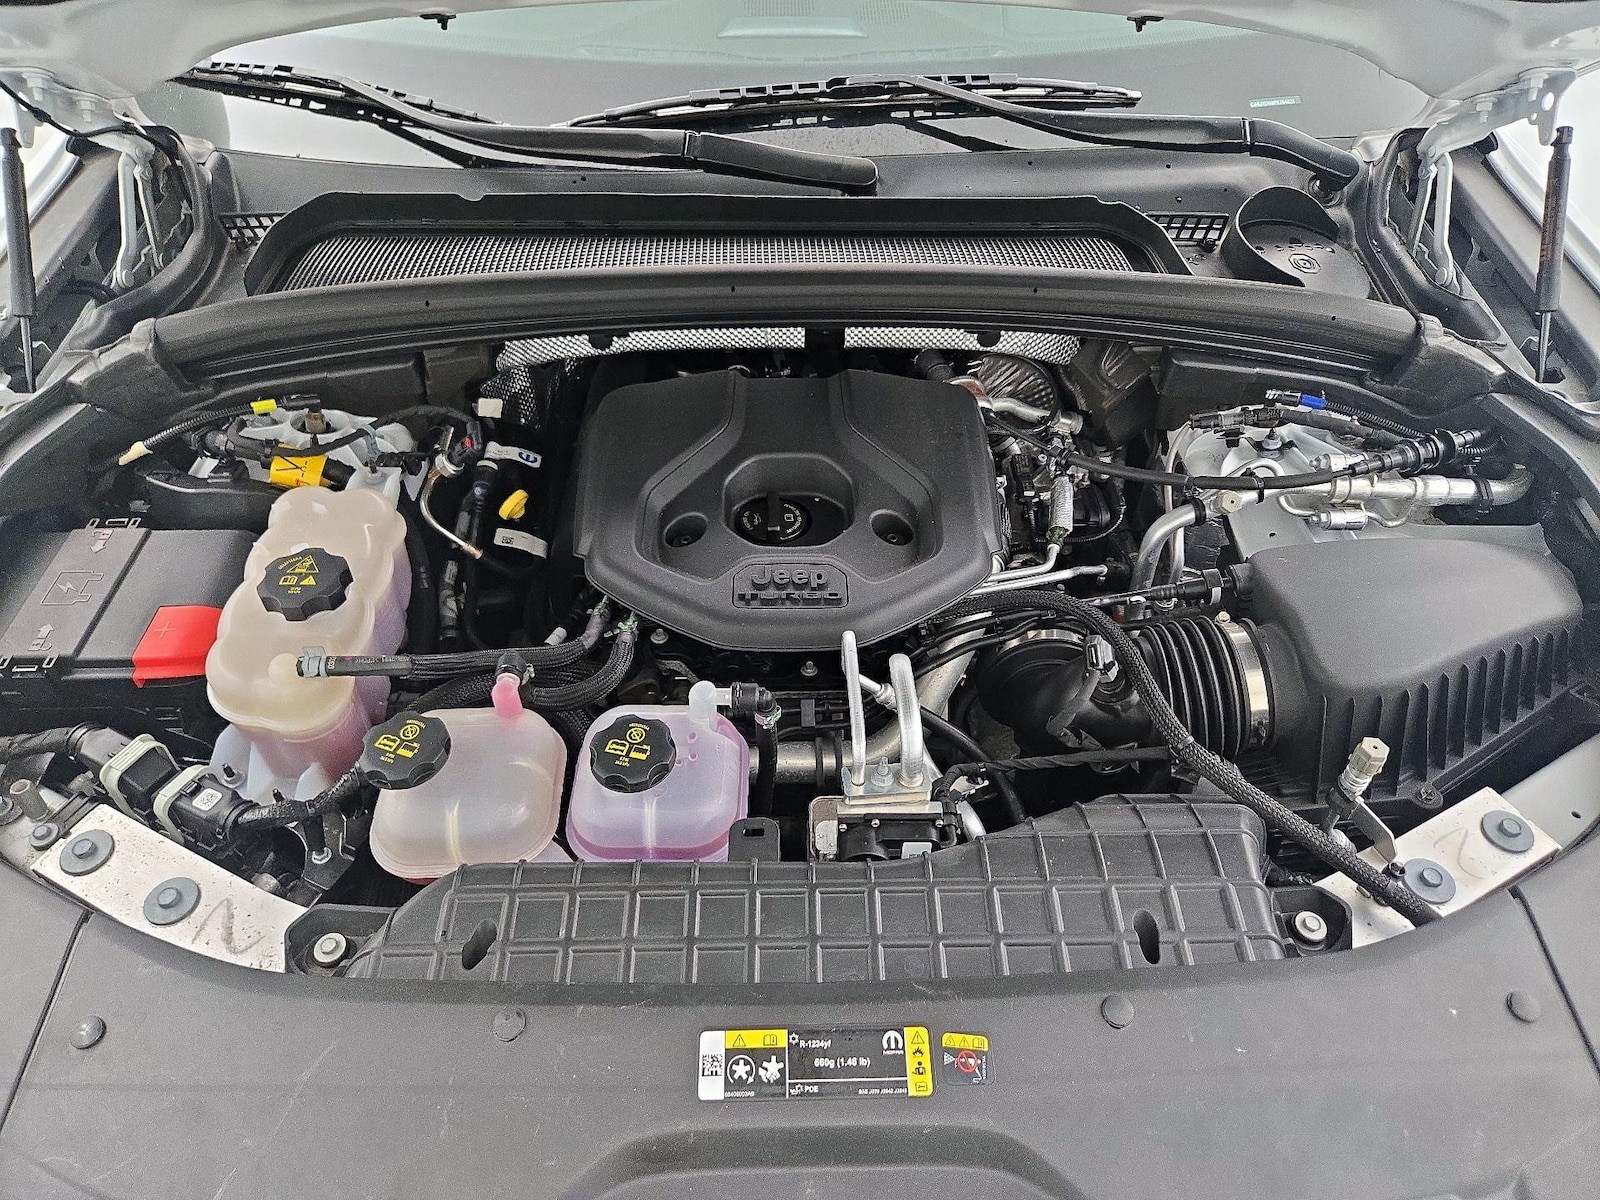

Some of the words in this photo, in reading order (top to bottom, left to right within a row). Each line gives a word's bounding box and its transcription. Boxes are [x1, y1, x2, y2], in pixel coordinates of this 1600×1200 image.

[751, 565, 831, 591] Jeep
[737, 590, 843, 606] TURBO
[799, 1039, 833, 1050] R-1234yf
[813, 1057, 836, 1069] 660g
[836, 1055, 858, 1069] (1.46
[858, 1055, 872, 1069] lb)
[804, 1085, 820, 1093] POE
